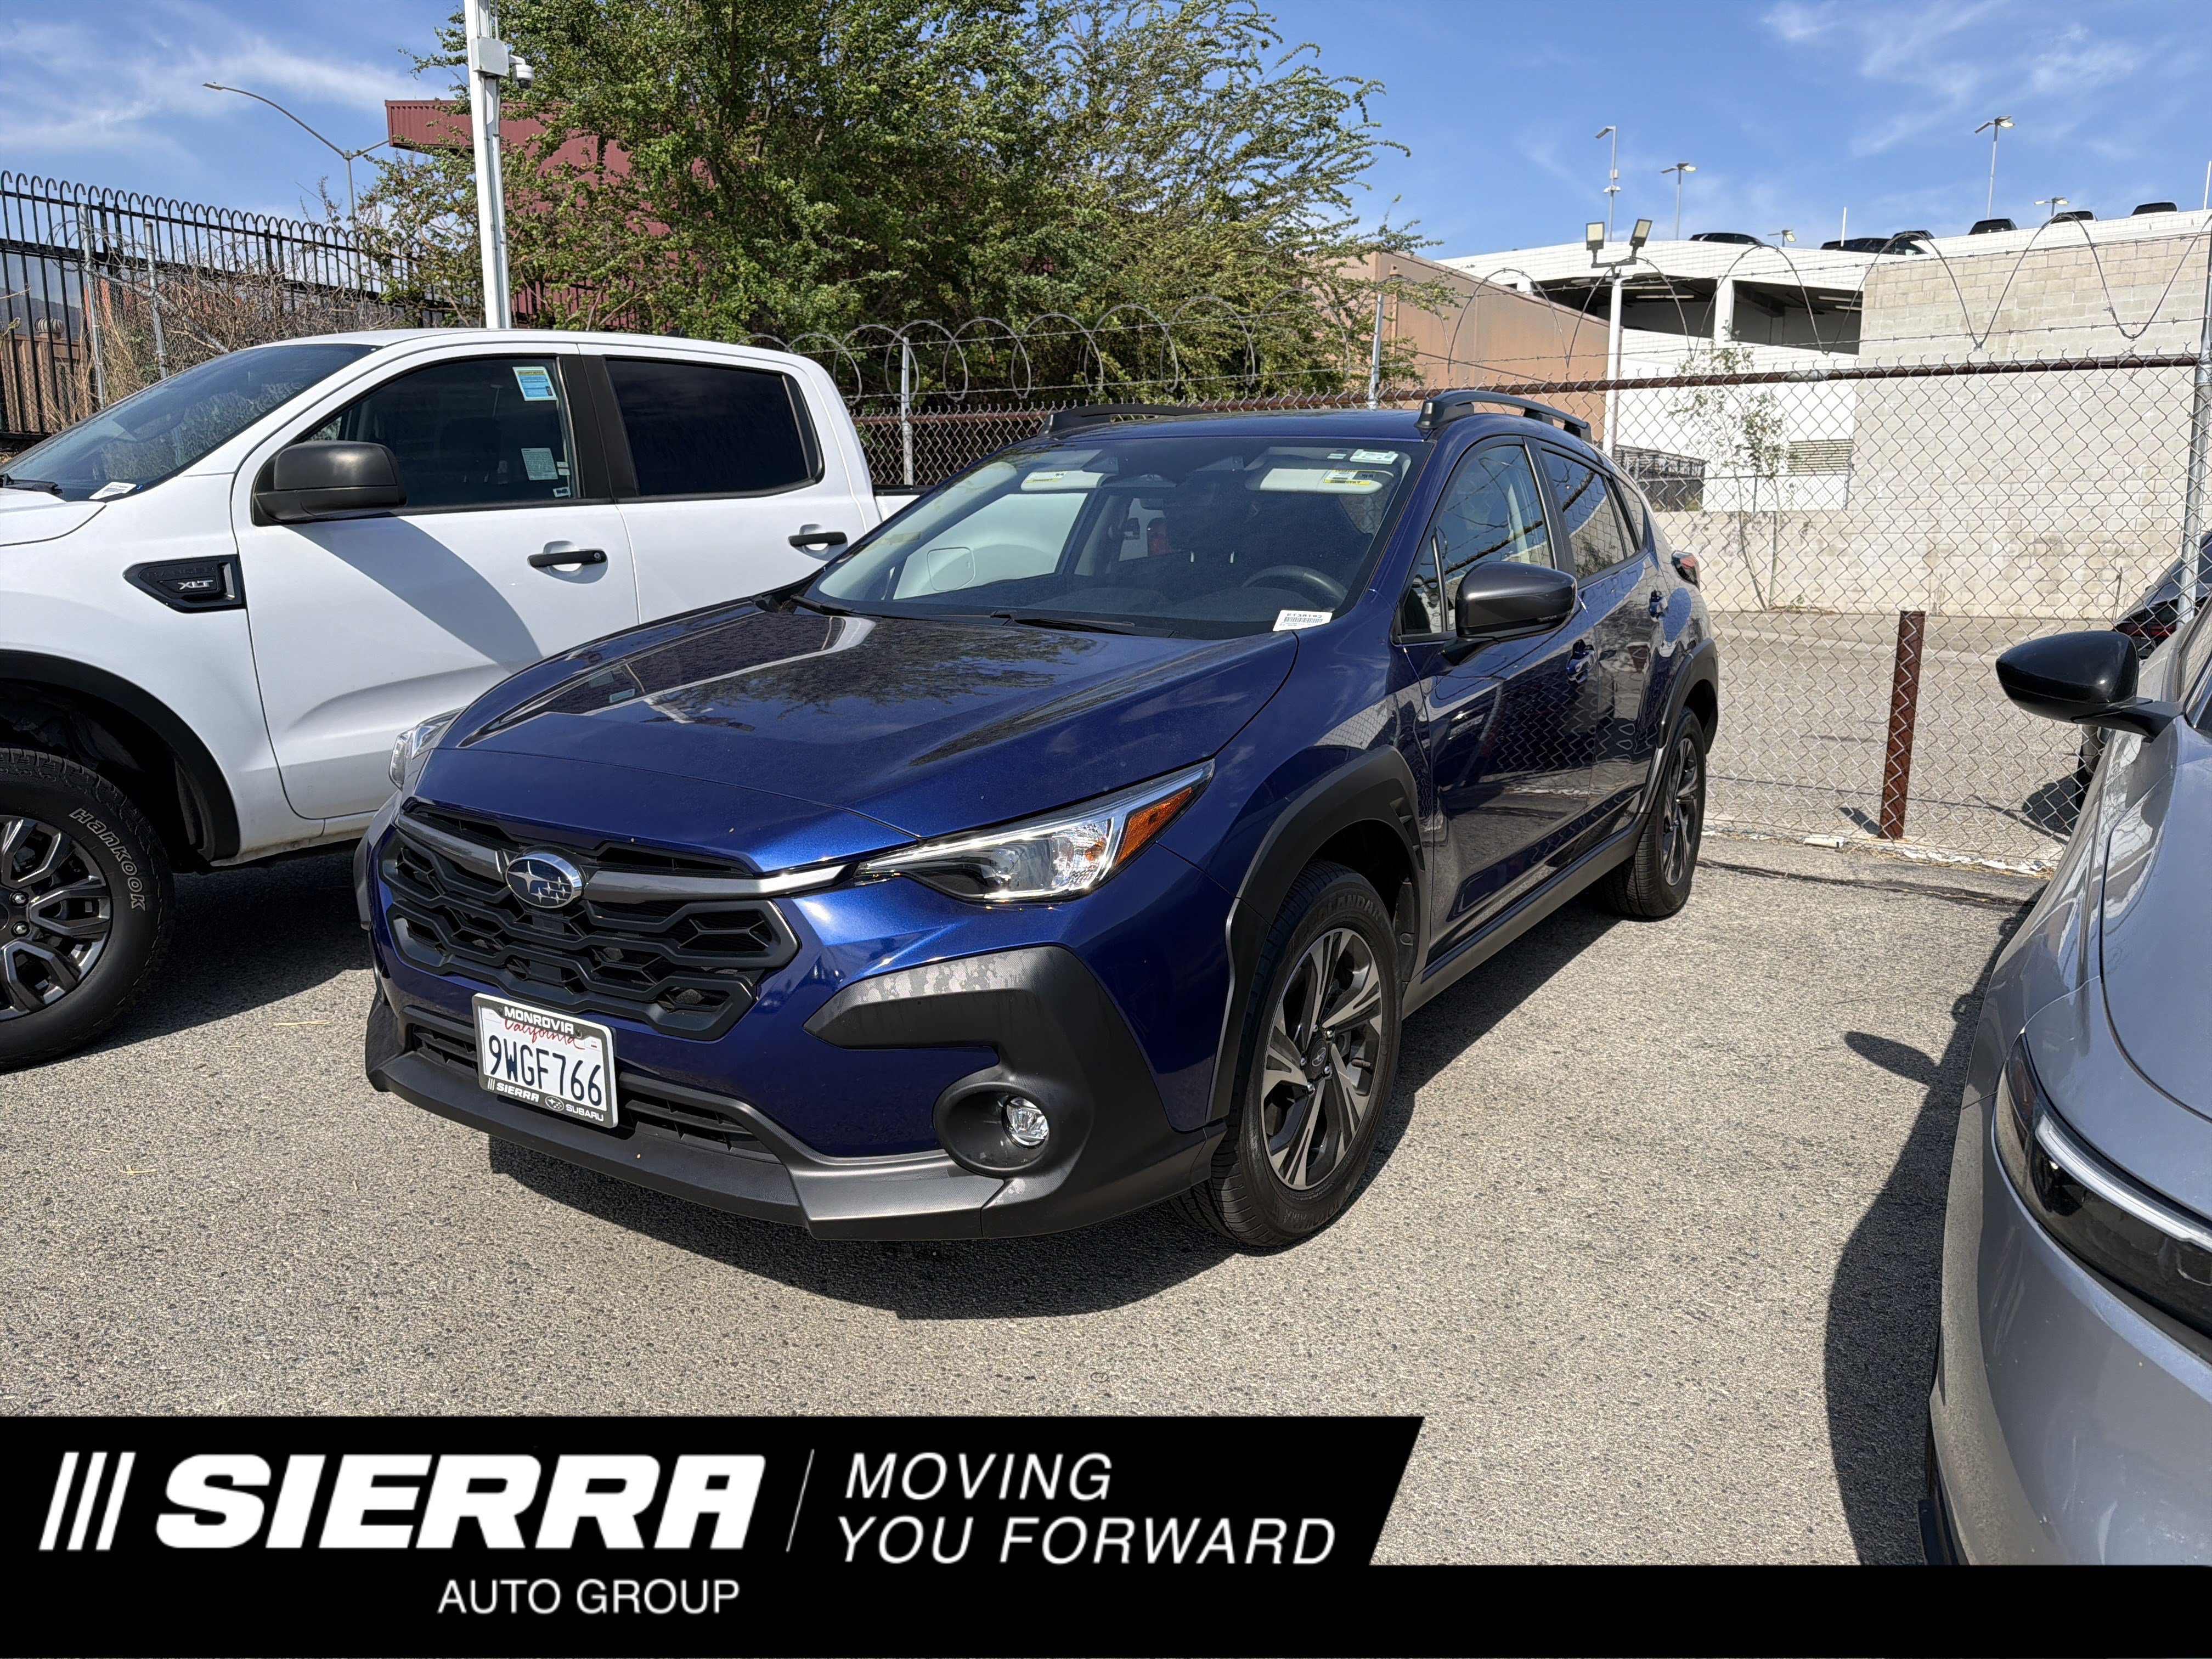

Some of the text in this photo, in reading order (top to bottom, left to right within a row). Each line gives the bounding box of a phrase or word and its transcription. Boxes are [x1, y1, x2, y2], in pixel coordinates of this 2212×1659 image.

[177, 579, 213, 590] XLT
[504, 1006, 574, 1035] MONROVIA
[489, 1035, 602, 1107] 9WGF766
[496, 1082, 604, 1121] SIERRA SUBARU
